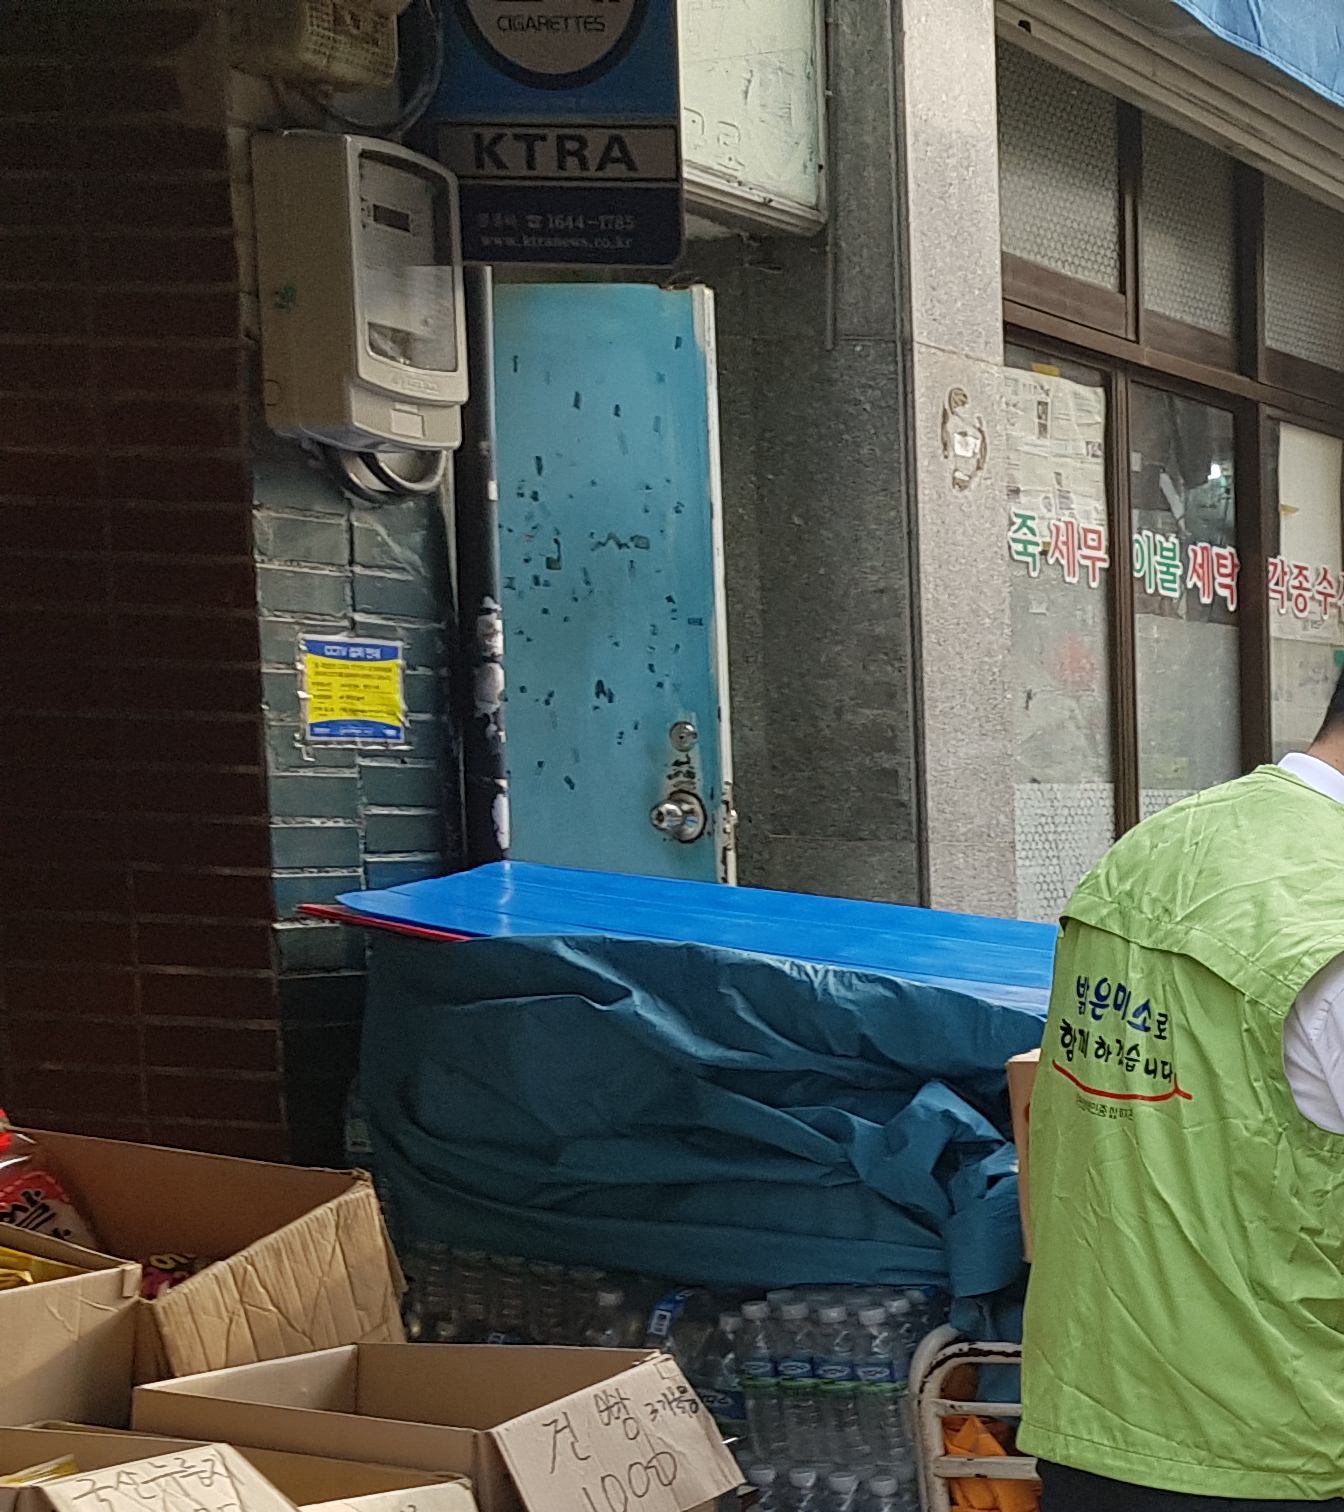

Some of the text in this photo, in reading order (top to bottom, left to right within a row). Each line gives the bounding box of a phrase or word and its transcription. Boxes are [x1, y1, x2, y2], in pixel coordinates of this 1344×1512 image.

[497, 15, 605, 33] CIGARETTES
[472, 131, 639, 172] KTRA
[1133, 531, 1240, 610] 이불 세탁
